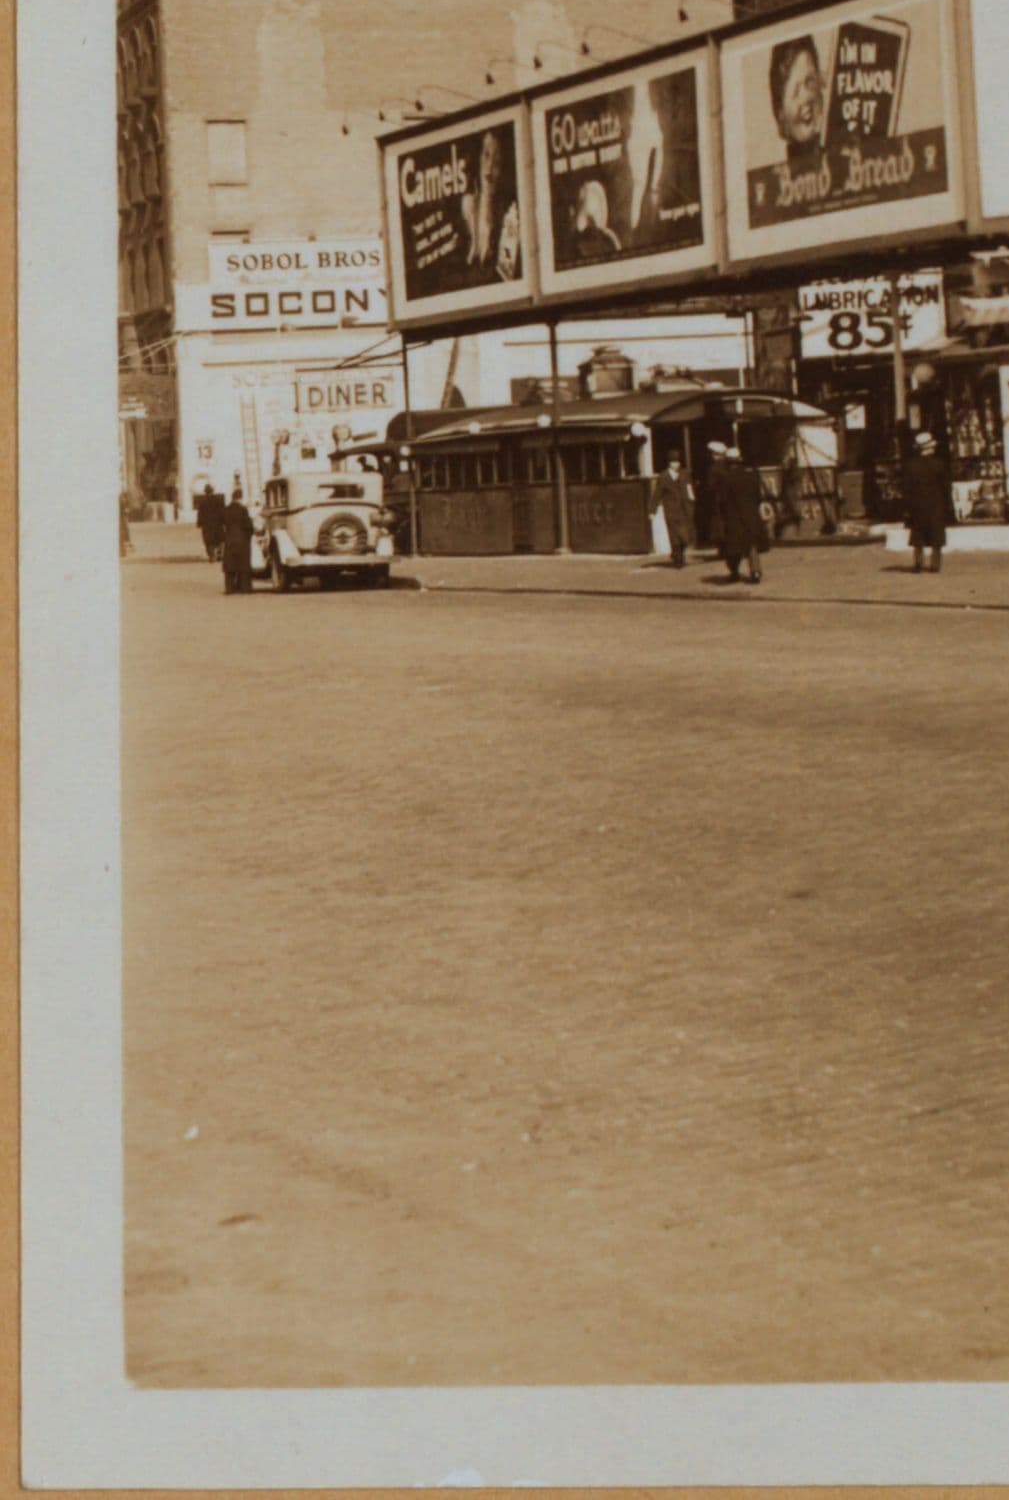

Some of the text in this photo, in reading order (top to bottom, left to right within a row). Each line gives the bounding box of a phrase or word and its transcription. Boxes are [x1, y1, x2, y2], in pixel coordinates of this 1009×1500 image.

[836, 68, 894, 97] FLAVOR
[550, 112, 577, 157] 60
[401, 143, 468, 208] Camels
[774, 134, 914, 207] Bond Bread
[226, 249, 382, 272] SOBOL BROS
[306, 381, 387, 409] DINER
